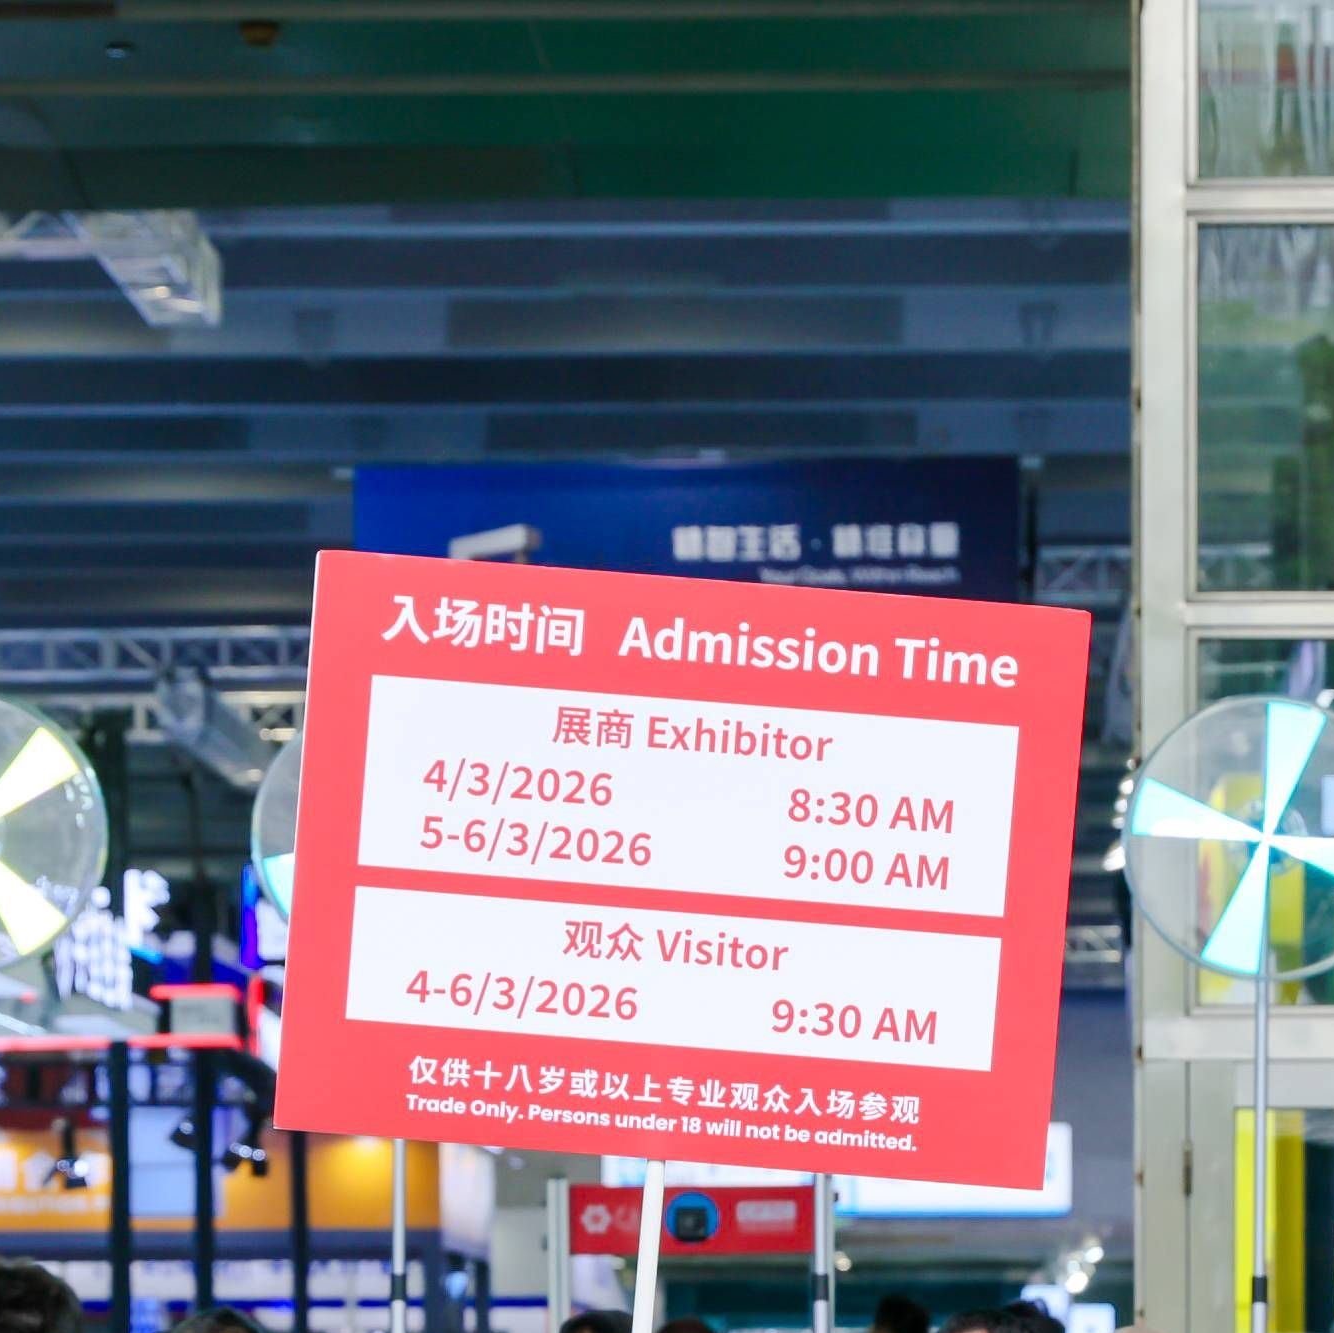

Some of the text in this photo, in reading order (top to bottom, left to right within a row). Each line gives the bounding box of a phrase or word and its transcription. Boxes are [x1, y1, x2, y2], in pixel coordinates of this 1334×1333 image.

[381, 594, 586, 657] 入场时间
[618, 615, 1020, 688] Admission Time
[551, 704, 834, 762] 展商 Exhibitor
[422, 757, 956, 834] 4/3/2026 8:30 AM
[419, 814, 950, 891] 5-6/3/2026 9:00 AM
[562, 919, 790, 971] 观众 Visitor
[405, 969, 938, 1045] 4-6/3/2026 9:30 AM
[405, 1093, 917, 1151] Trade Only. Persons under 18 will not be admitted.
[408, 1055, 921, 1125] 仅供十八岁或以上专业观众入场参观
